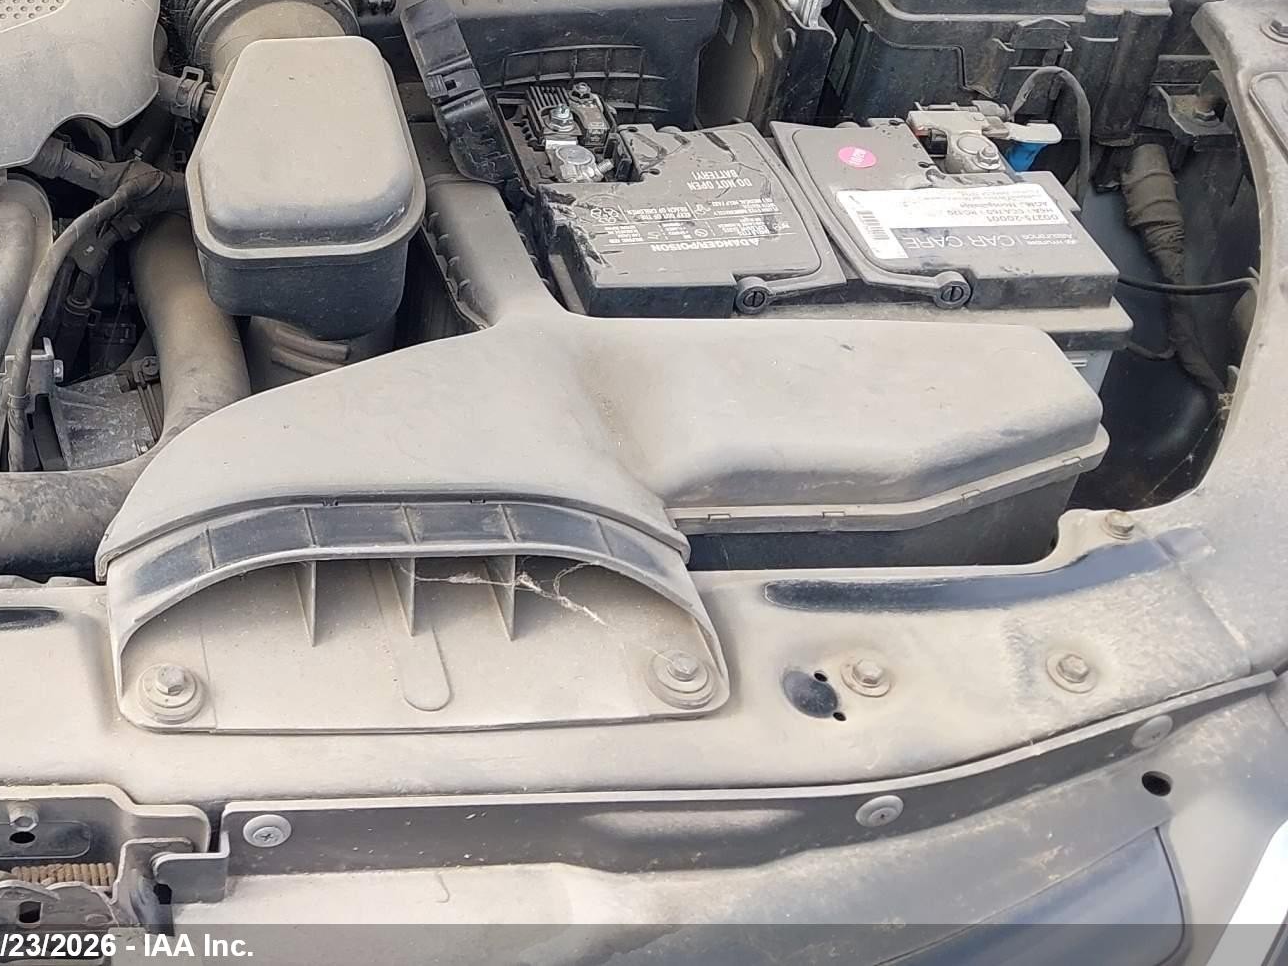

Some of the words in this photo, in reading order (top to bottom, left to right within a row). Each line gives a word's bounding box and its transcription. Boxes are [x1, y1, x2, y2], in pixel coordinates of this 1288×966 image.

[691, 169, 739, 180] BATTERY!
[686, 180, 714, 191] OPEN
[714, 178, 736, 189] NOT
[736, 177, 753, 188] DO
[650, 238, 751, 252] DANGER/POISON
[901, 235, 963, 249] CARE
[966, 234, 1016, 248] CAR
